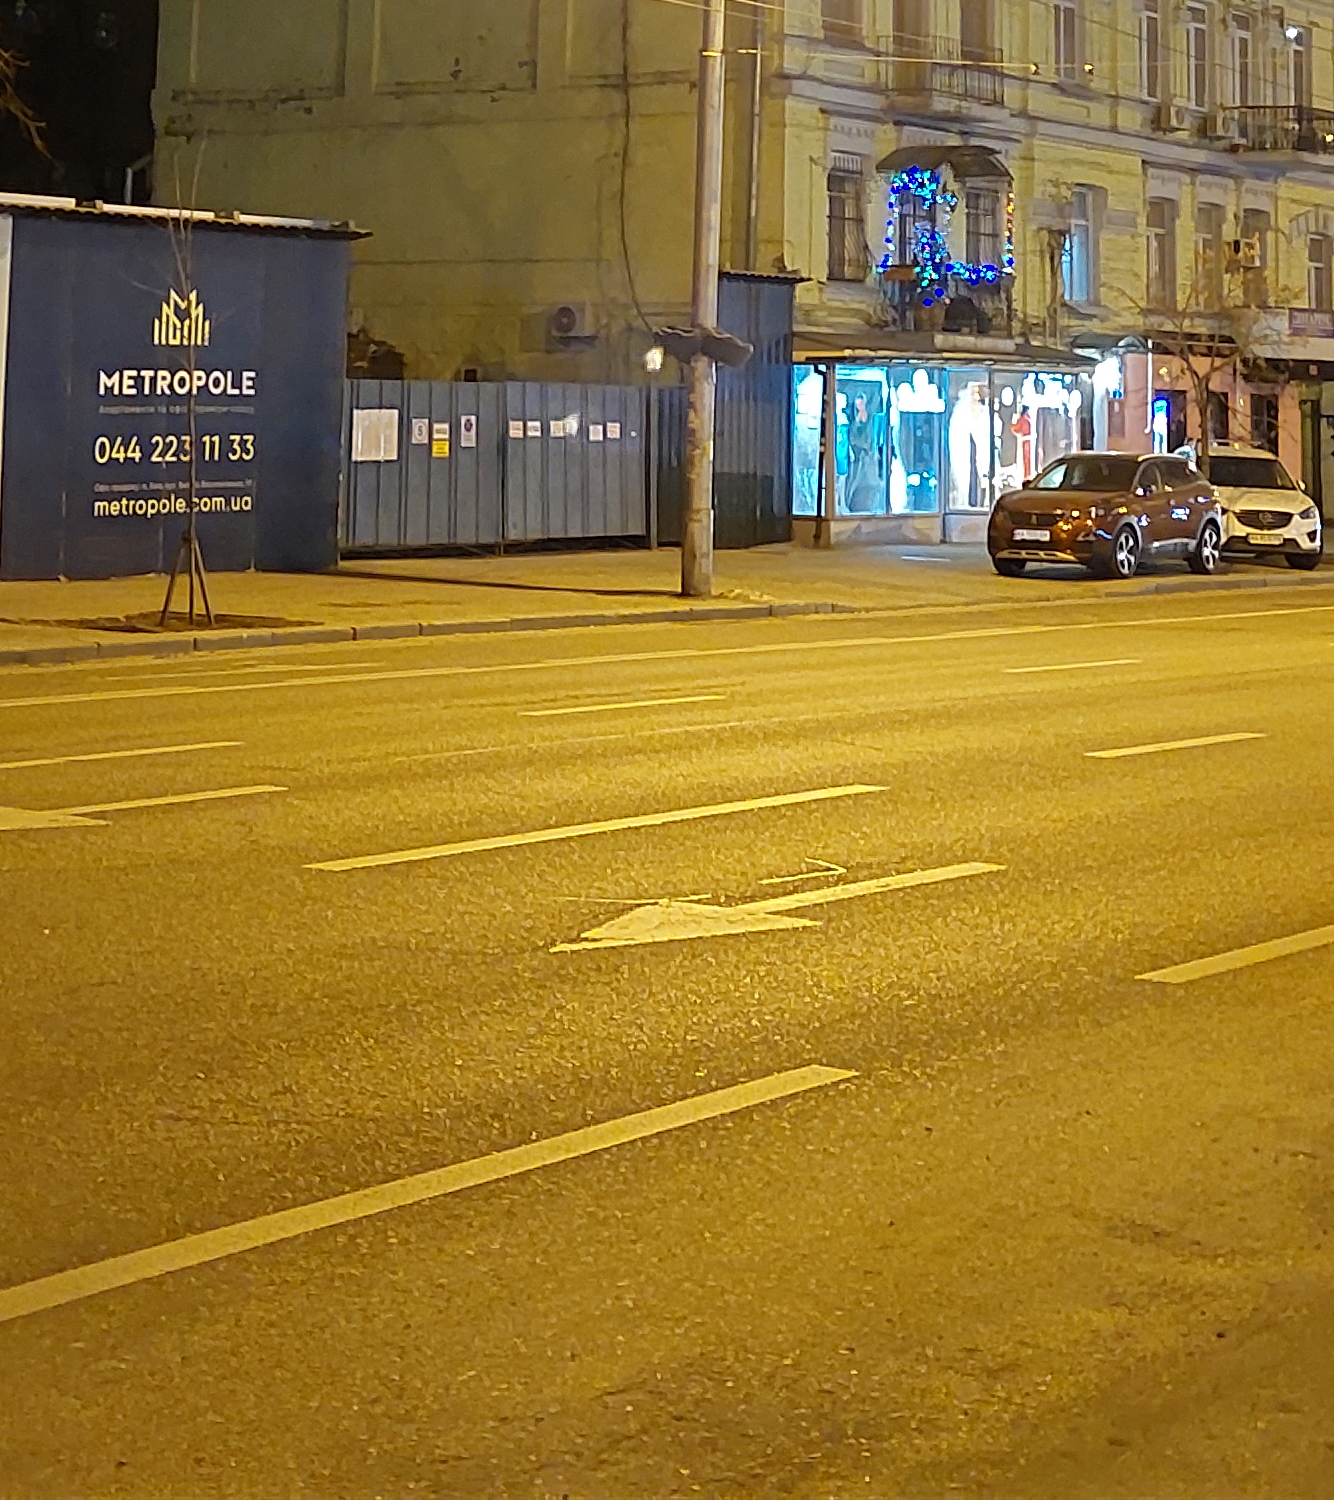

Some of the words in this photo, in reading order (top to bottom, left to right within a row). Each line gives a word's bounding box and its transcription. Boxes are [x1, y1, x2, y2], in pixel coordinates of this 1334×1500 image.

[98, 369, 257, 396] METROPOLE
[94, 436, 142, 464] 044
[150, 435, 191, 463] 223
[202, 434, 220, 462] 11
[228, 434, 255, 461] 33
[93, 492, 252, 519] metropole.com.ua
